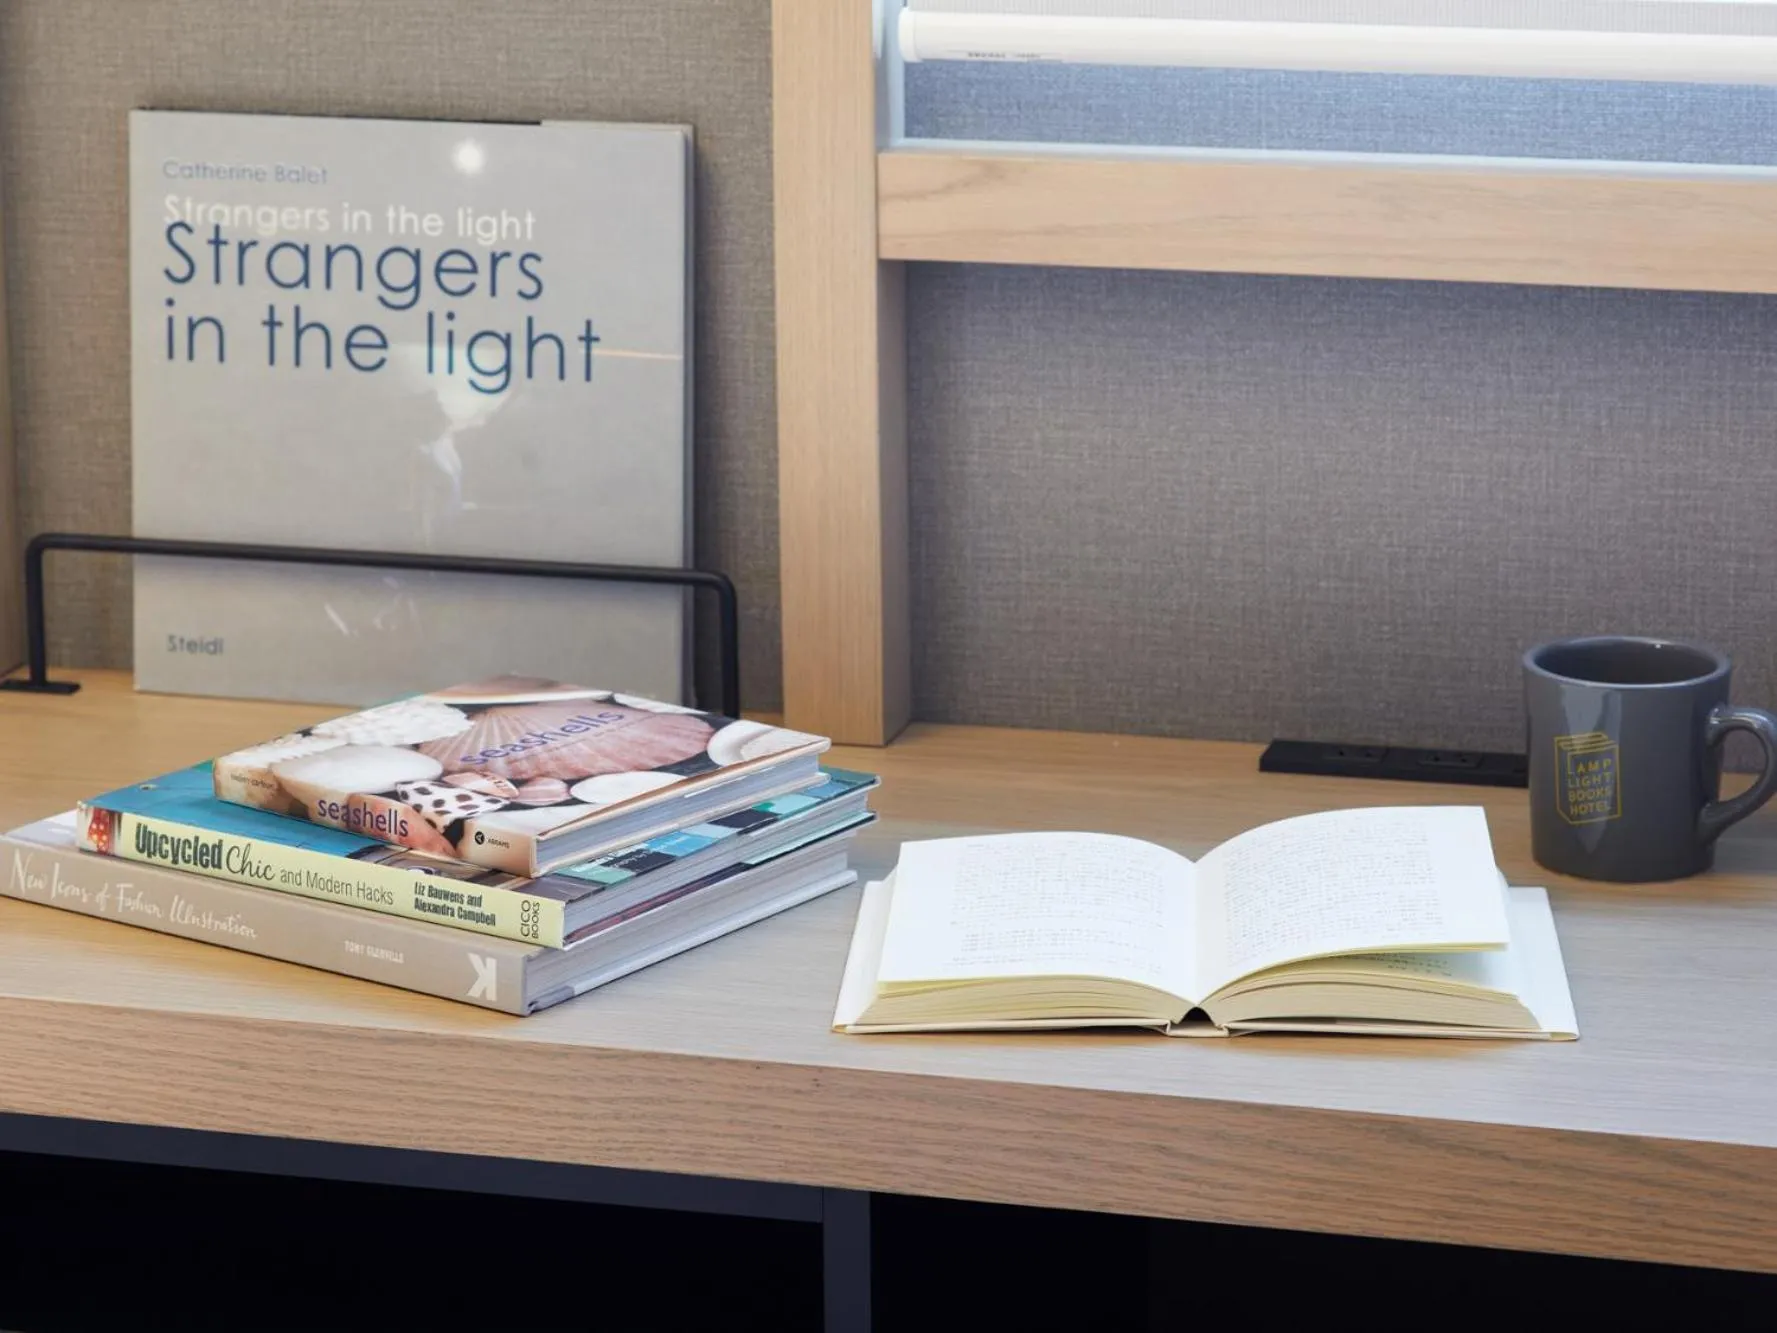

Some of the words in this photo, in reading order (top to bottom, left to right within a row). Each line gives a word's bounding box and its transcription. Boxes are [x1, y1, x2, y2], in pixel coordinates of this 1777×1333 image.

[162, 160, 267, 183] Catherine
[274, 164, 328, 184] Balet
[163, 194, 330, 236] Strangers
[343, 202, 372, 234] in
[386, 204, 444, 237] the
[457, 206, 536, 246] light
[163, 220, 545, 311] Strangers
[165, 298, 226, 364] in
[261, 304, 389, 372] the
[426, 310, 601, 394] light
[166, 634, 224, 655] Steidl
[460, 711, 625, 766] seashells
[317, 798, 409, 838] seashells
[135, 822, 223, 870] Upcycled
[225, 842, 276, 881] Chic
[280, 868, 302, 887] and
[306, 870, 352, 897] Modern
[356, 883, 394, 906] Hacks
[8, 848, 48, 897] New
[115, 883, 163, 918] Fashion
[169, 894, 258, 939] Illustration
[414, 881, 425, 896] Liz
[428, 885, 465, 904] Bauwens
[467, 894, 483, 908] and
[414, 897, 455, 917] Alexandra
[457, 906, 496, 926] Campbell
[520, 899, 531, 937] CICO
[531, 902, 540, 939] BOOKS
